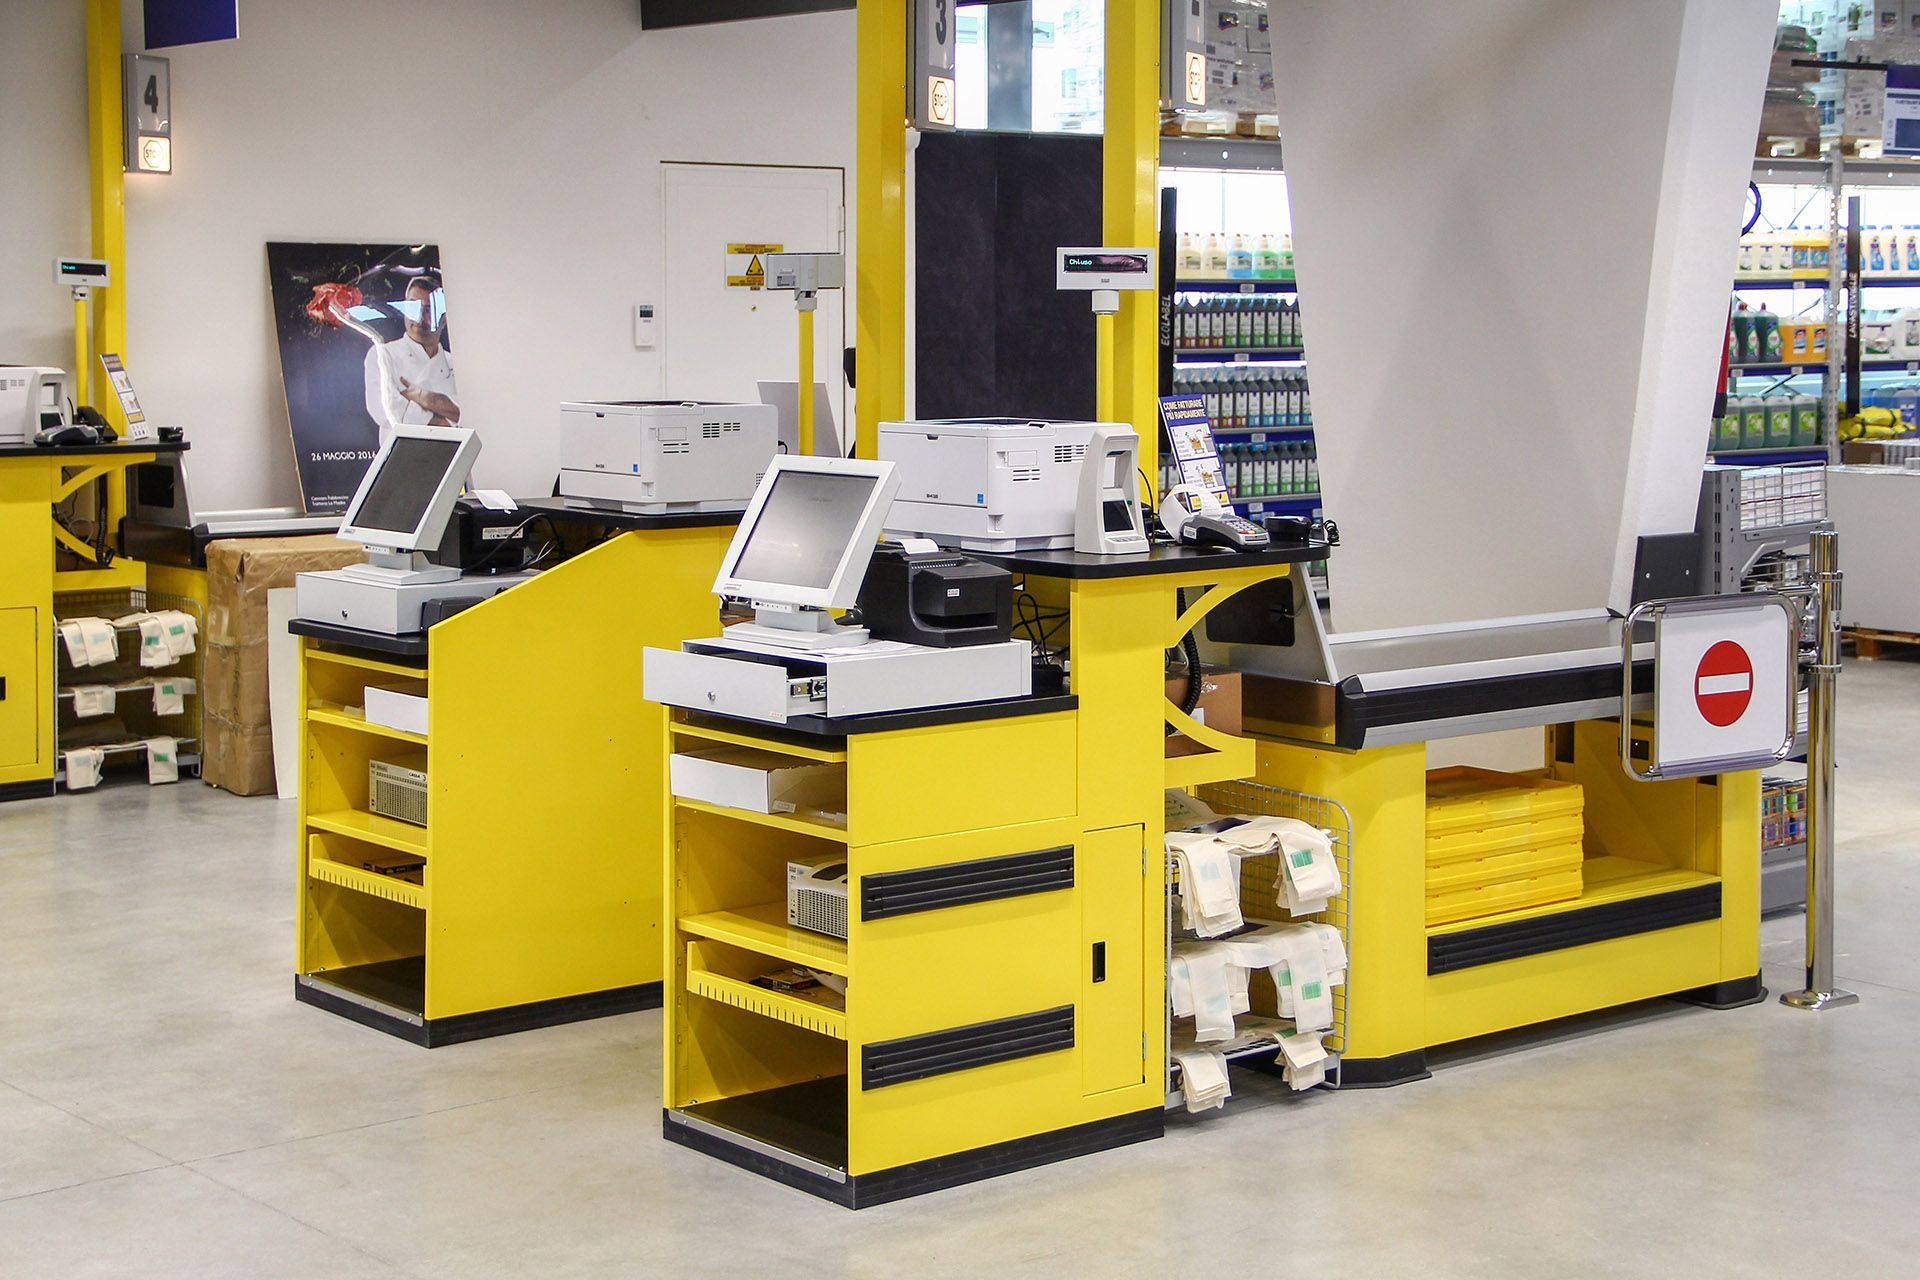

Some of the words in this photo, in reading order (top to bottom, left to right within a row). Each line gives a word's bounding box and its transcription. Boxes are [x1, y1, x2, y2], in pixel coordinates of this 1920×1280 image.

[936, 0, 947, 45] 3
[144, 75, 159, 113] 4
[933, 93, 948, 107] STOP
[1069, 258, 1093, 266] Chiuso
[1161, 294, 1171, 346] ECOLABEL
[1163, 401, 1178, 411] COME
[1177, 399, 1204, 409] FATTURARE
[1174, 409, 1206, 420] RAPIDAMENTE
[311, 452, 321, 461] 26
[323, 451, 356, 461] MAGGIO
[358, 451, 376, 460] 2016
